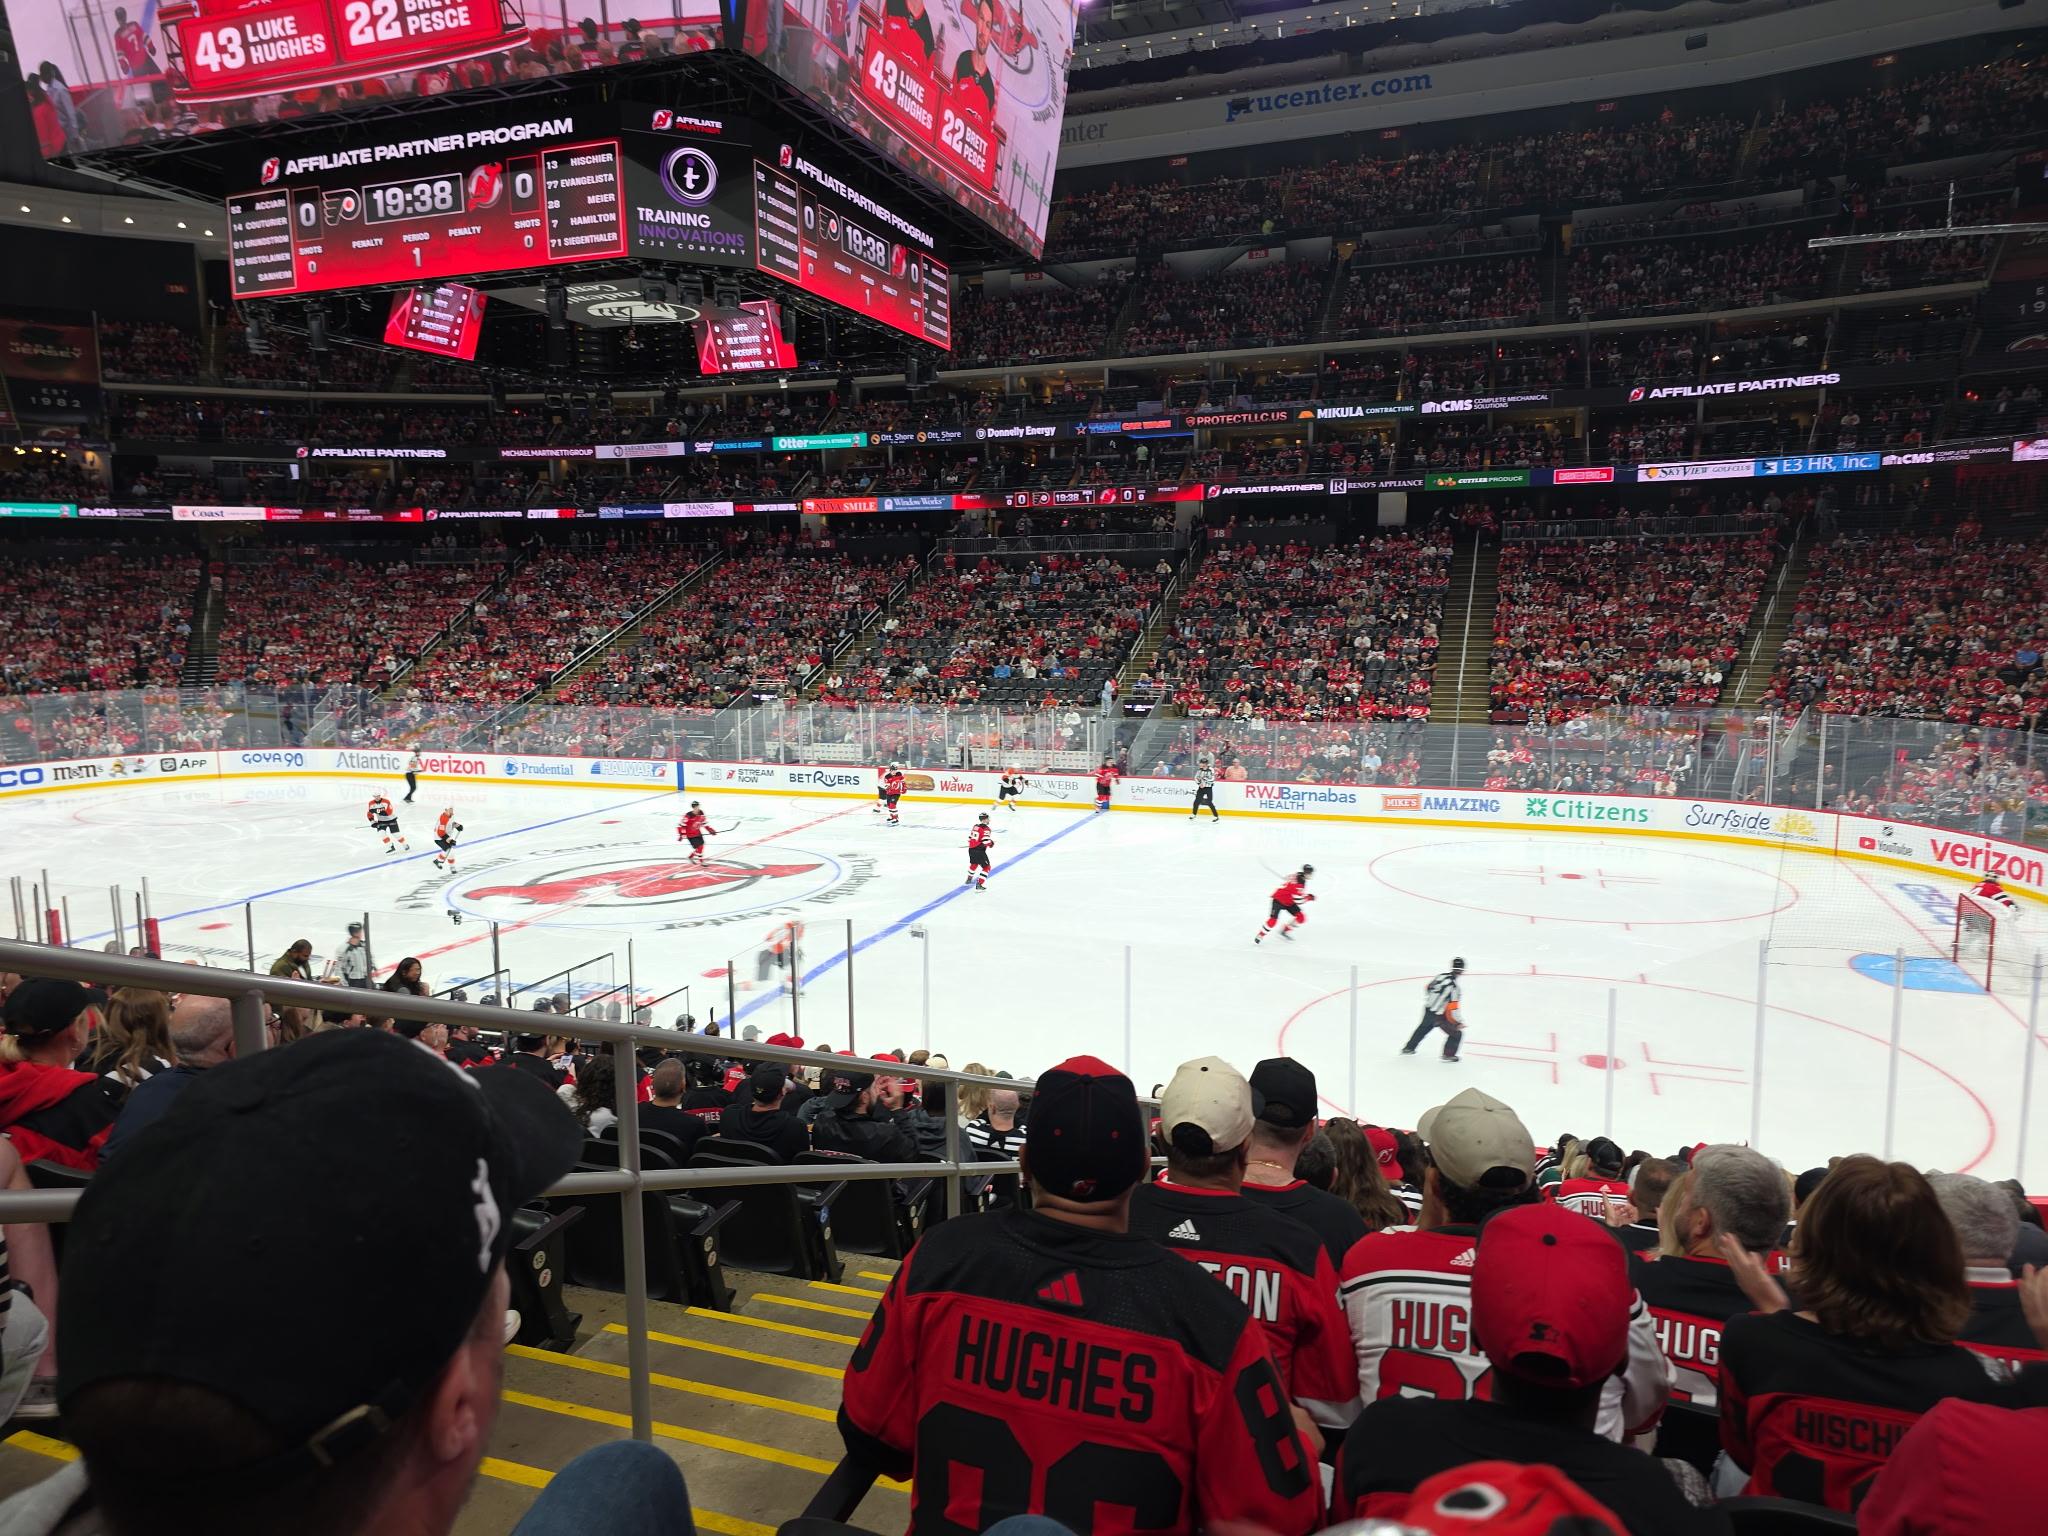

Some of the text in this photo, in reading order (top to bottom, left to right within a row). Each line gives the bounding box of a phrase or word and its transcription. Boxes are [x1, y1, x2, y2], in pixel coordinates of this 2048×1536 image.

[245, 16, 298, 42] LUKE
[345, 0, 402, 46] 22
[407, 7, 471, 35] PESCE
[195, 27, 246, 72] 43
[250, 33, 326, 64] HUGHES
[869, 50, 897, 99] 43
[900, 70, 924, 102] LUKE
[897, 90, 933, 130] HUGHES
[676, 116, 722, 128] AFFILIATE
[941, 109, 964, 154] 22
[285, 118, 573, 175] AFFILIATE PARTNER PROGRAM
[965, 126, 987, 155] BRETT
[546, 153, 613, 170] 13 HISCHIER
[963, 145, 986, 173] PESCE
[560, 173, 614, 188] EVANGELISTA
[300, 173, 533, 227] 0 19:38 0
[587, 193, 615, 205] MEIER
[796, 158, 934, 248] AFFILIATE PARTNER PROGRAM
[552, 213, 616, 228] 7 HAMILTON
[637, 207, 711, 228] TRAINING
[352, 238, 383, 248] PENALTY
[403, 232, 430, 243] PERIOD
[448, 226, 481, 237] PENALTY
[514, 218, 540, 229] SHOTS
[550, 232, 617, 248] 71 SIEGENTHALER
[639, 223, 744, 247] INNOVATIONS
[678, 243, 745, 255] COMPANY
[804, 205, 815, 230] 0
[846, 225, 885, 267] 19:38
[910, 264, 918, 283] 0
[308, 235, 533, 272] 0 1 0
[1649, 373, 1840, 399] AFFILIATE PARTNERS
[30, 396, 81, 408] 1982
[1441, 394, 1549, 412] CMS COMPLETE MECHANICAL
[1197, 411, 1287, 426] PROTECTLLC.US
[1317, 405, 1414, 419] MIKULA CONTRACTING
[894, 433, 914, 441] Shore
[987, 426, 1056, 438] Donnelly Energy
[779, 438, 809, 449] Otter
[312, 447, 446, 458] AFFILIATE PARTNERS
[1902, 452, 1934, 464] CMS
[1782, 453, 1873, 473] E3 HR, Inc.
[1222, 483, 1324, 495] AFFILIATE PARTNERS
[1379, 479, 1424, 488] APPLIANCE
[893, 497, 944, 507] Window Works
[1018, 495, 1026, 504] 0
[1055, 493, 1079, 502] 19:38
[1124, 490, 1132, 500] 0
[192, 509, 225, 518] Coast
[843, 501, 875, 511] SMILE
[242, 752, 303, 767] GOYA 90
[335, 751, 400, 770] Atlantic
[418, 755, 485, 775] verizon
[521, 762, 574, 776] Prudential
[600, 761, 652, 776] HALMAR
[738, 768, 774, 777] STREAM
[0, 767, 44, 788] CO
[738, 775, 759, 783] NOW
[940, 778, 974, 793] Wawa
[1048, 781, 1079, 790] WEBB
[1131, 785, 1144, 794] EAT
[1260, 800, 1304, 811] HEALTH
[1386, 797, 1500, 813] MIKE'S AMAZING
[1552, 799, 1648, 824] Citizens
[1686, 804, 1770, 830] Surfside
[1878, 840, 1913, 857] YouTube
[1931, 839, 2043, 886] verizon
[1169, 1231, 1200, 1241] adidas
[1392, 1300, 1475, 1355] HUG
[1653, 1317, 1721, 1365] HUG
[954, 1314, 1156, 1424] HUGHES
[1795, 1408, 1905, 1460] HISCH
